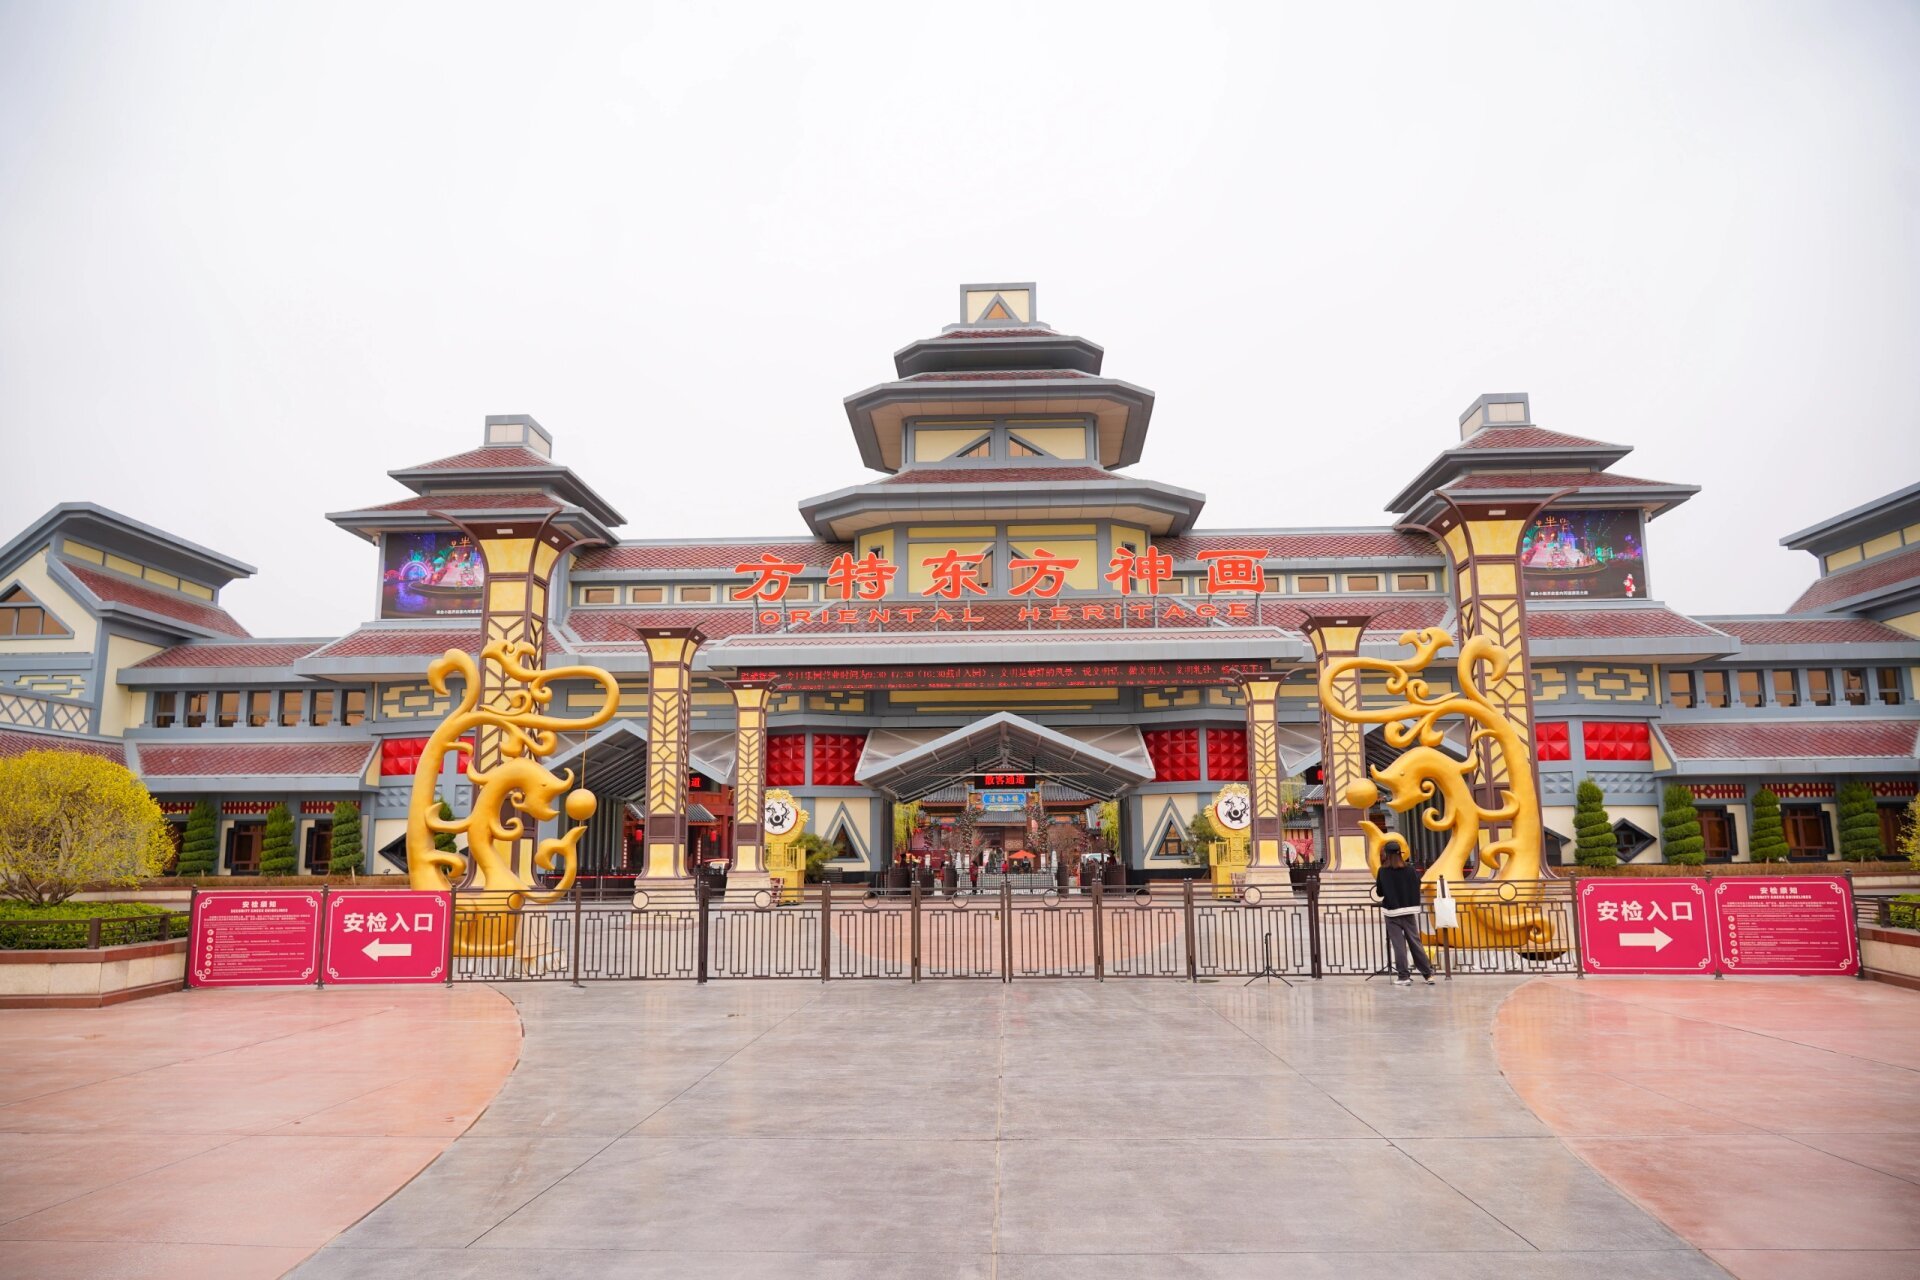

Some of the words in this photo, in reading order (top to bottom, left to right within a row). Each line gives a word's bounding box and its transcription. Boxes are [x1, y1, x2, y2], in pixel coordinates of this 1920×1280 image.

[733, 545, 1270, 601] 方特东方神画
[758, 607, 985, 626] ORIENTAL
[1018, 603, 1250, 622] HERITAGE
[1597, 900, 1693, 922] 安检入口
[343, 912, 433, 933] 安检入口
